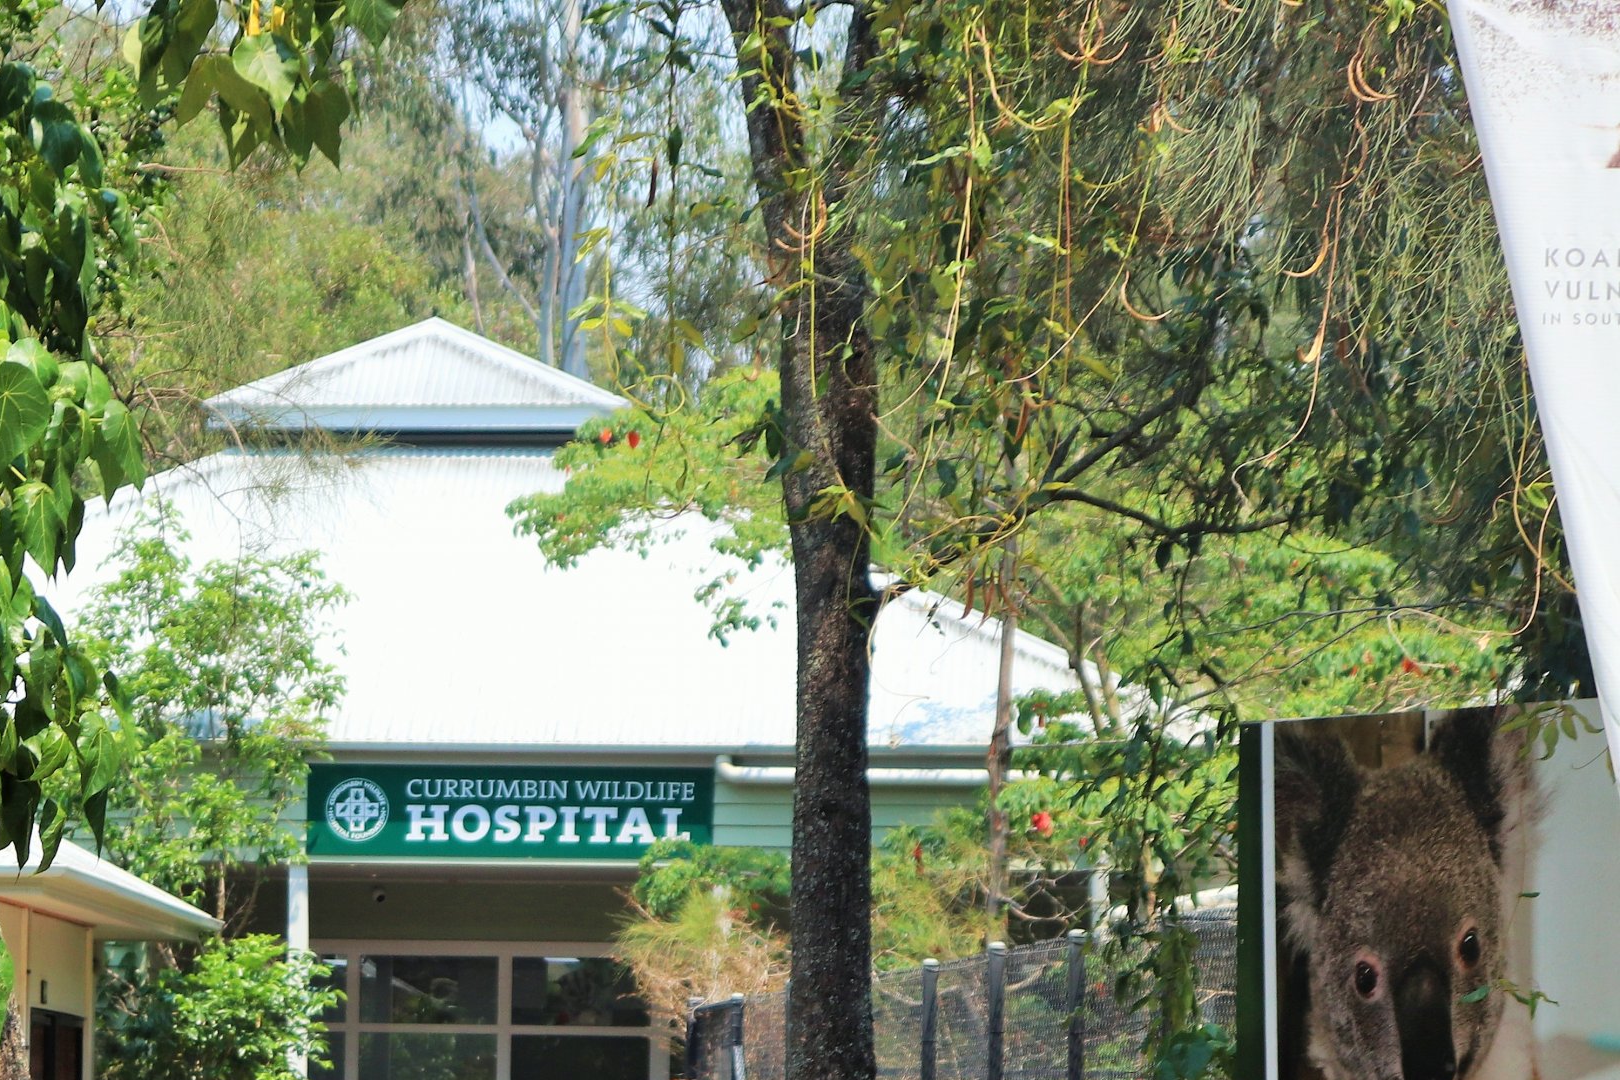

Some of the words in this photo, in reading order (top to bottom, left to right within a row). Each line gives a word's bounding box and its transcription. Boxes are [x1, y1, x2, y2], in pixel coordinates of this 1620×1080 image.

[1544, 247, 1620, 268] KOA
[1541, 312, 1561, 325] IN
[405, 778, 569, 800] CURRUMBIN
[573, 780, 696, 801] WILDLIFE
[404, 803, 691, 844] HOSPITAL
